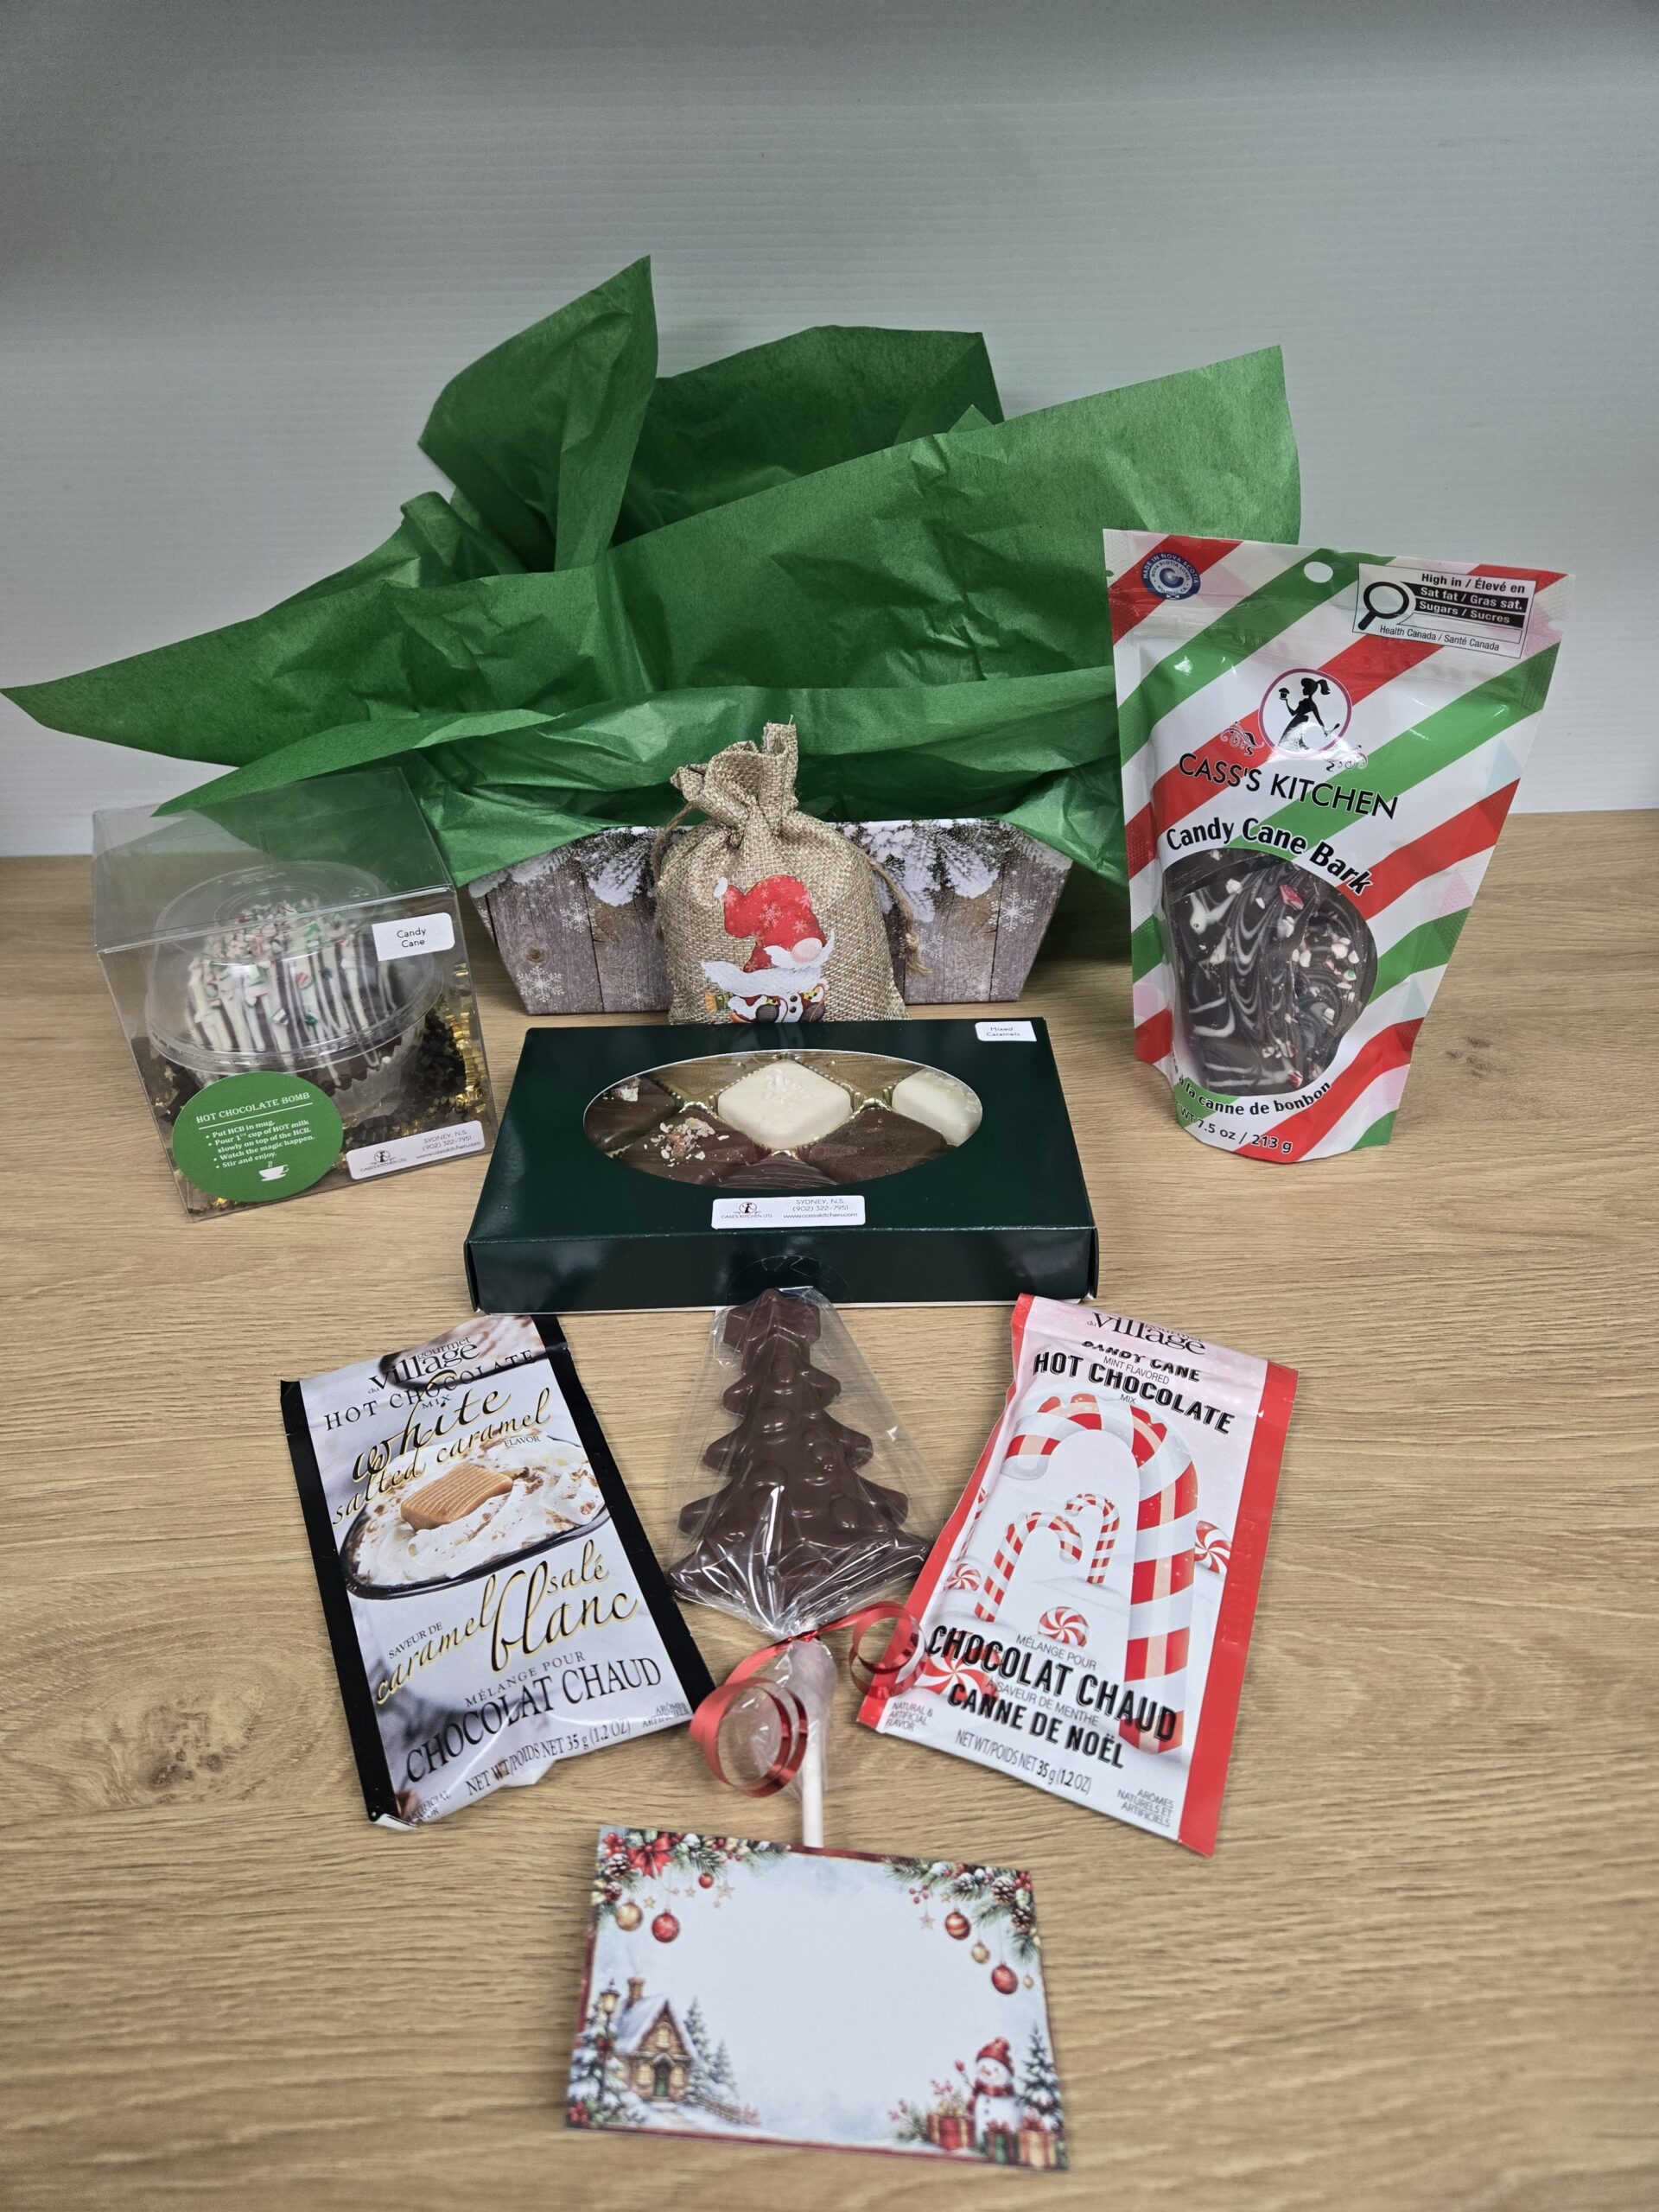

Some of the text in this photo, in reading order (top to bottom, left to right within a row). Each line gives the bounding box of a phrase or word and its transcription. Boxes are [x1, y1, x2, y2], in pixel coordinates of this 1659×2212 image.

[1142, 561, 1152, 579] MADE
[1161, 553, 1181, 563] NOVA
[1183, 562, 1198, 584] SCOTIA
[1421, 573, 1447, 586] High
[1451, 576, 1462, 587] in
[1474, 578, 1507, 592] Élevé
[1510, 584, 1525, 594] en
[1419, 601, 1459, 615] Sugars
[1470, 610, 1510, 624] Sucres
[1420, 587, 1439, 598] Sat
[1442, 588, 1459, 601] fat
[1470, 595, 1497, 607] Gras
[1500, 600, 1522, 610] sat.
[1380, 625, 1405, 636] Health
[1407, 629, 1436, 641] Canada
[1444, 634, 1467, 645] Santé
[1469, 639, 1500, 652] Canada
[1179, 753, 1399, 821] CASS'S KITCHEN
[1166, 817, 1375, 895] Candy Cane Bark
[397, 927, 426, 938] Candy
[401, 939, 425, 948] Cane
[196, 1091, 310, 1124] HOT CHOCOLATE BOMB
[1185, 1082, 1196, 1098] la
[1198, 1096, 1245, 1116] canne
[1249, 1102, 1270, 1116] de
[1274, 1081, 1332, 1113] bonbon
[214, 1137, 234, 1147] Pour
[248, 1130, 263, 1139] cup
[272, 1124, 290, 1133] HOT
[291, 1120, 309, 1128] milk
[218, 1143, 243, 1154] slowly
[255, 1137, 269, 1146] top
[219, 1151, 245, 1160] Watch
[260, 1142, 283, 1153] magic
[284, 1135, 315, 1147] happen.
[422, 1142, 442, 1151] (902)
[1180, 1108, 1293, 1154] WT 7.5 oz / 213 g
[417, 1336, 472, 1361] gourmet
[1103, 1356, 1170, 1384] MINT FLAVORED
[1149, 1358, 1201, 1382] CANE
[323, 1350, 536, 1431] HOT CHOCOLATE
[422, 1394, 452, 1409] MIX
[1033, 1351, 1236, 1434] HOT CHOCOLATE
[1120, 1393, 1137, 1404] MIX
[332, 1387, 551, 1525] salted caramel
[504, 1434, 541, 1447] FLAVOR
[547, 1539, 609, 1594] salé
[491, 1560, 639, 1673] blanc
[376, 1573, 498, 1705] caramel
[388, 1622, 443, 1659] SAVEUR DE
[1015, 1632, 1097, 1672] MÉLANGE POUR
[465, 1650, 586, 1708] MÉLANGE POUR
[925, 1624, 1178, 1742] CHOCOLAT CHAUD
[405, 1656, 662, 1784] CHOCOLAT CHAUD
[893, 1702, 925, 1715] NATURAL
[995, 1682, 1037, 1707] SAVEUR
[1039, 1697, 1053, 1711] DE
[1054, 1700, 1099, 1726] MENTHE
[948, 1682, 1125, 1770] CANNE DE NOËL
[465, 1770, 492, 1797] NET
[543, 1738, 564, 1759] NET
[567, 1732, 580, 1747] 35
[589, 1723, 609, 1746] (1.2
[611, 1719, 632, 1738] OZ)
[955, 1729, 974, 1749] NET
[1018, 1751, 1037, 1773] NET
[1036, 1760, 1049, 1778] 35
[1048, 1768, 1056, 1785] g
[1057, 1767, 1074, 1788] (1.2
[1074, 1774, 1092, 1795] OZ)
